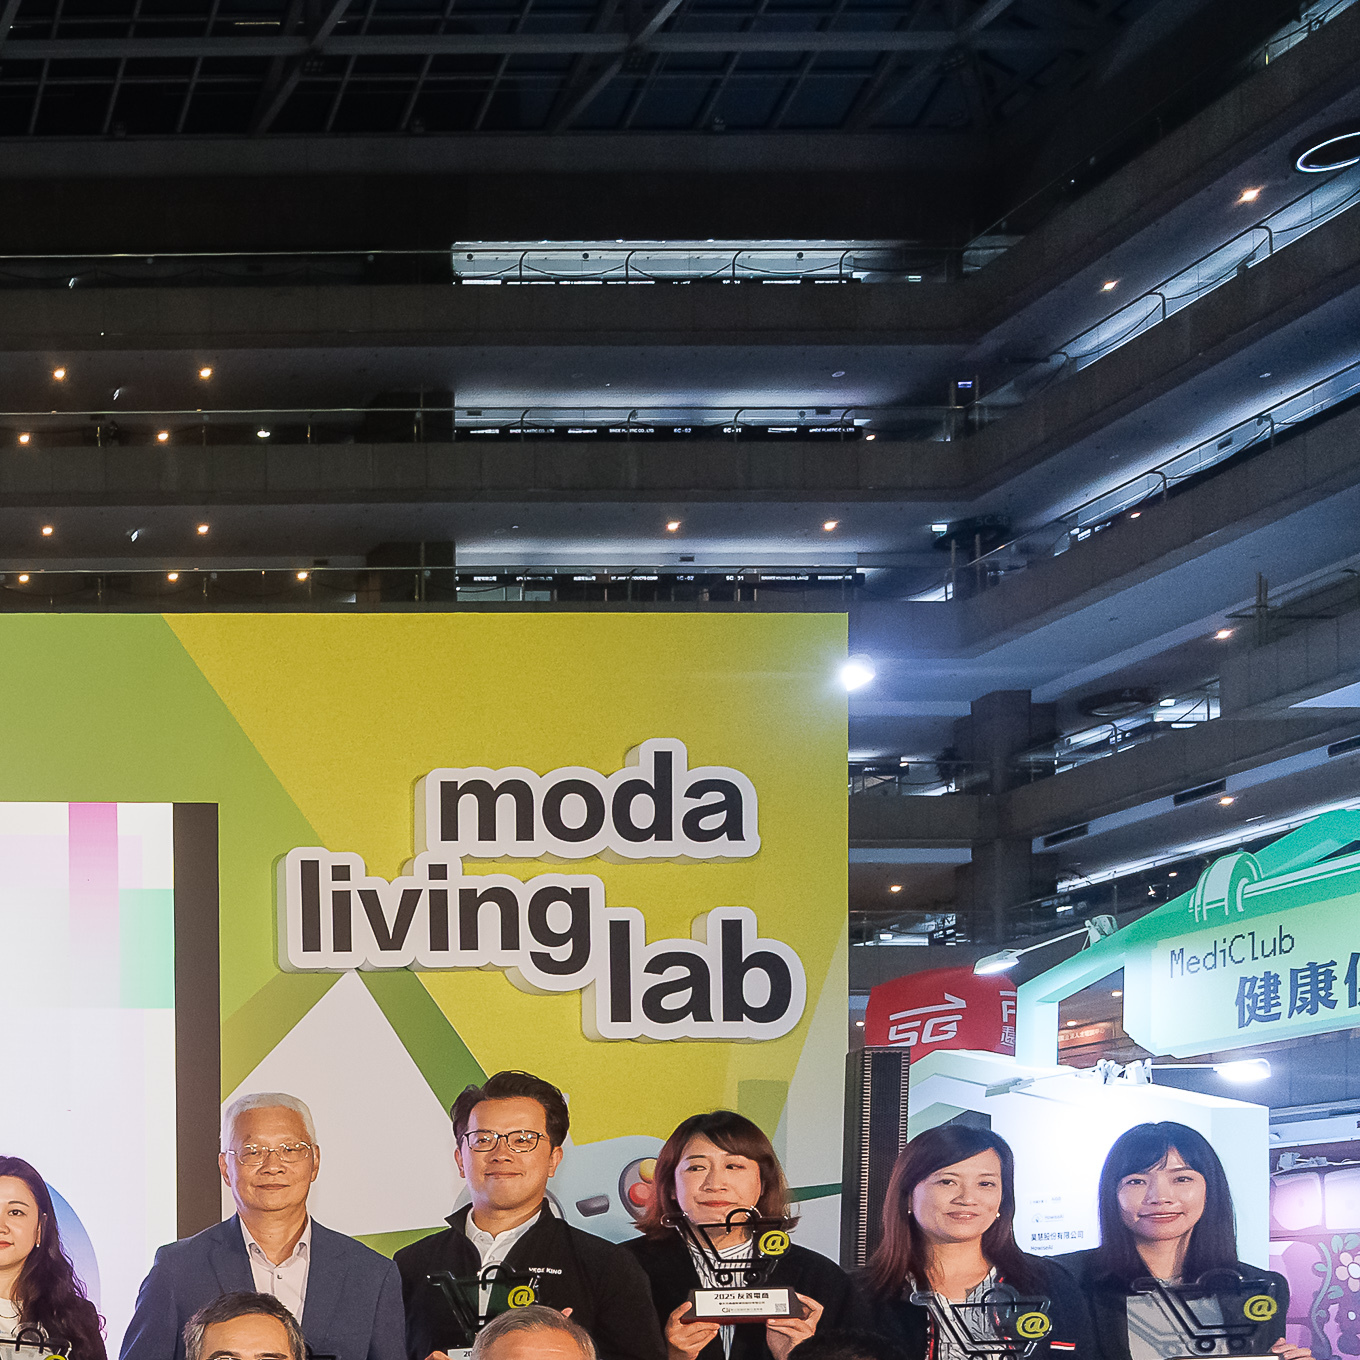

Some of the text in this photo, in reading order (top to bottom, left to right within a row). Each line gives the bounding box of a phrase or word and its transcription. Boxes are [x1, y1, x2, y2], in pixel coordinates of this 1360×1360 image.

[439, 750, 745, 843] moda
[300, 859, 590, 975] living
[1170, 925, 1297, 979] MediClub
[607, 918, 792, 1023] lab
[888, 1014, 963, 1047] 5G
